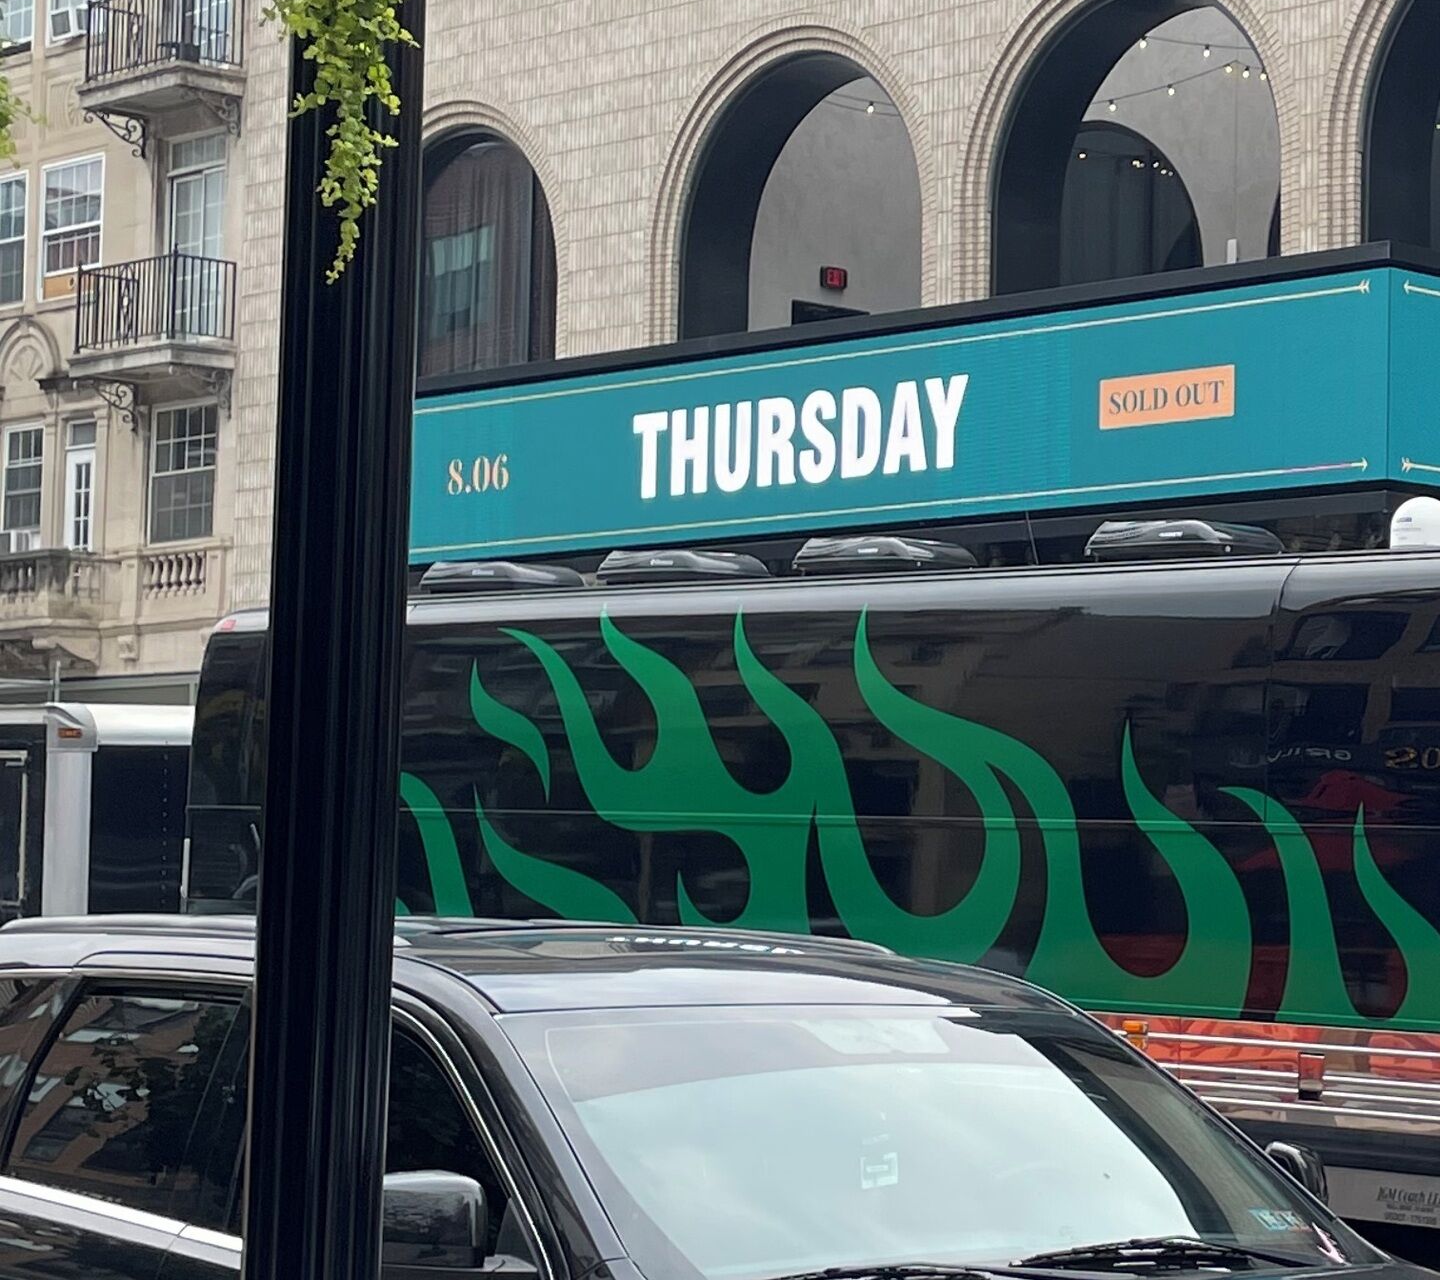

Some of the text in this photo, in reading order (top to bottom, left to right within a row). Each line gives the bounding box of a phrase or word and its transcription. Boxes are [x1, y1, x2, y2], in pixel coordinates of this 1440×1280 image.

[1108, 380, 1225, 416] SOLD OUT
[633, 374, 969, 499] THURSDAY
[448, 453, 509, 496] 8.06
